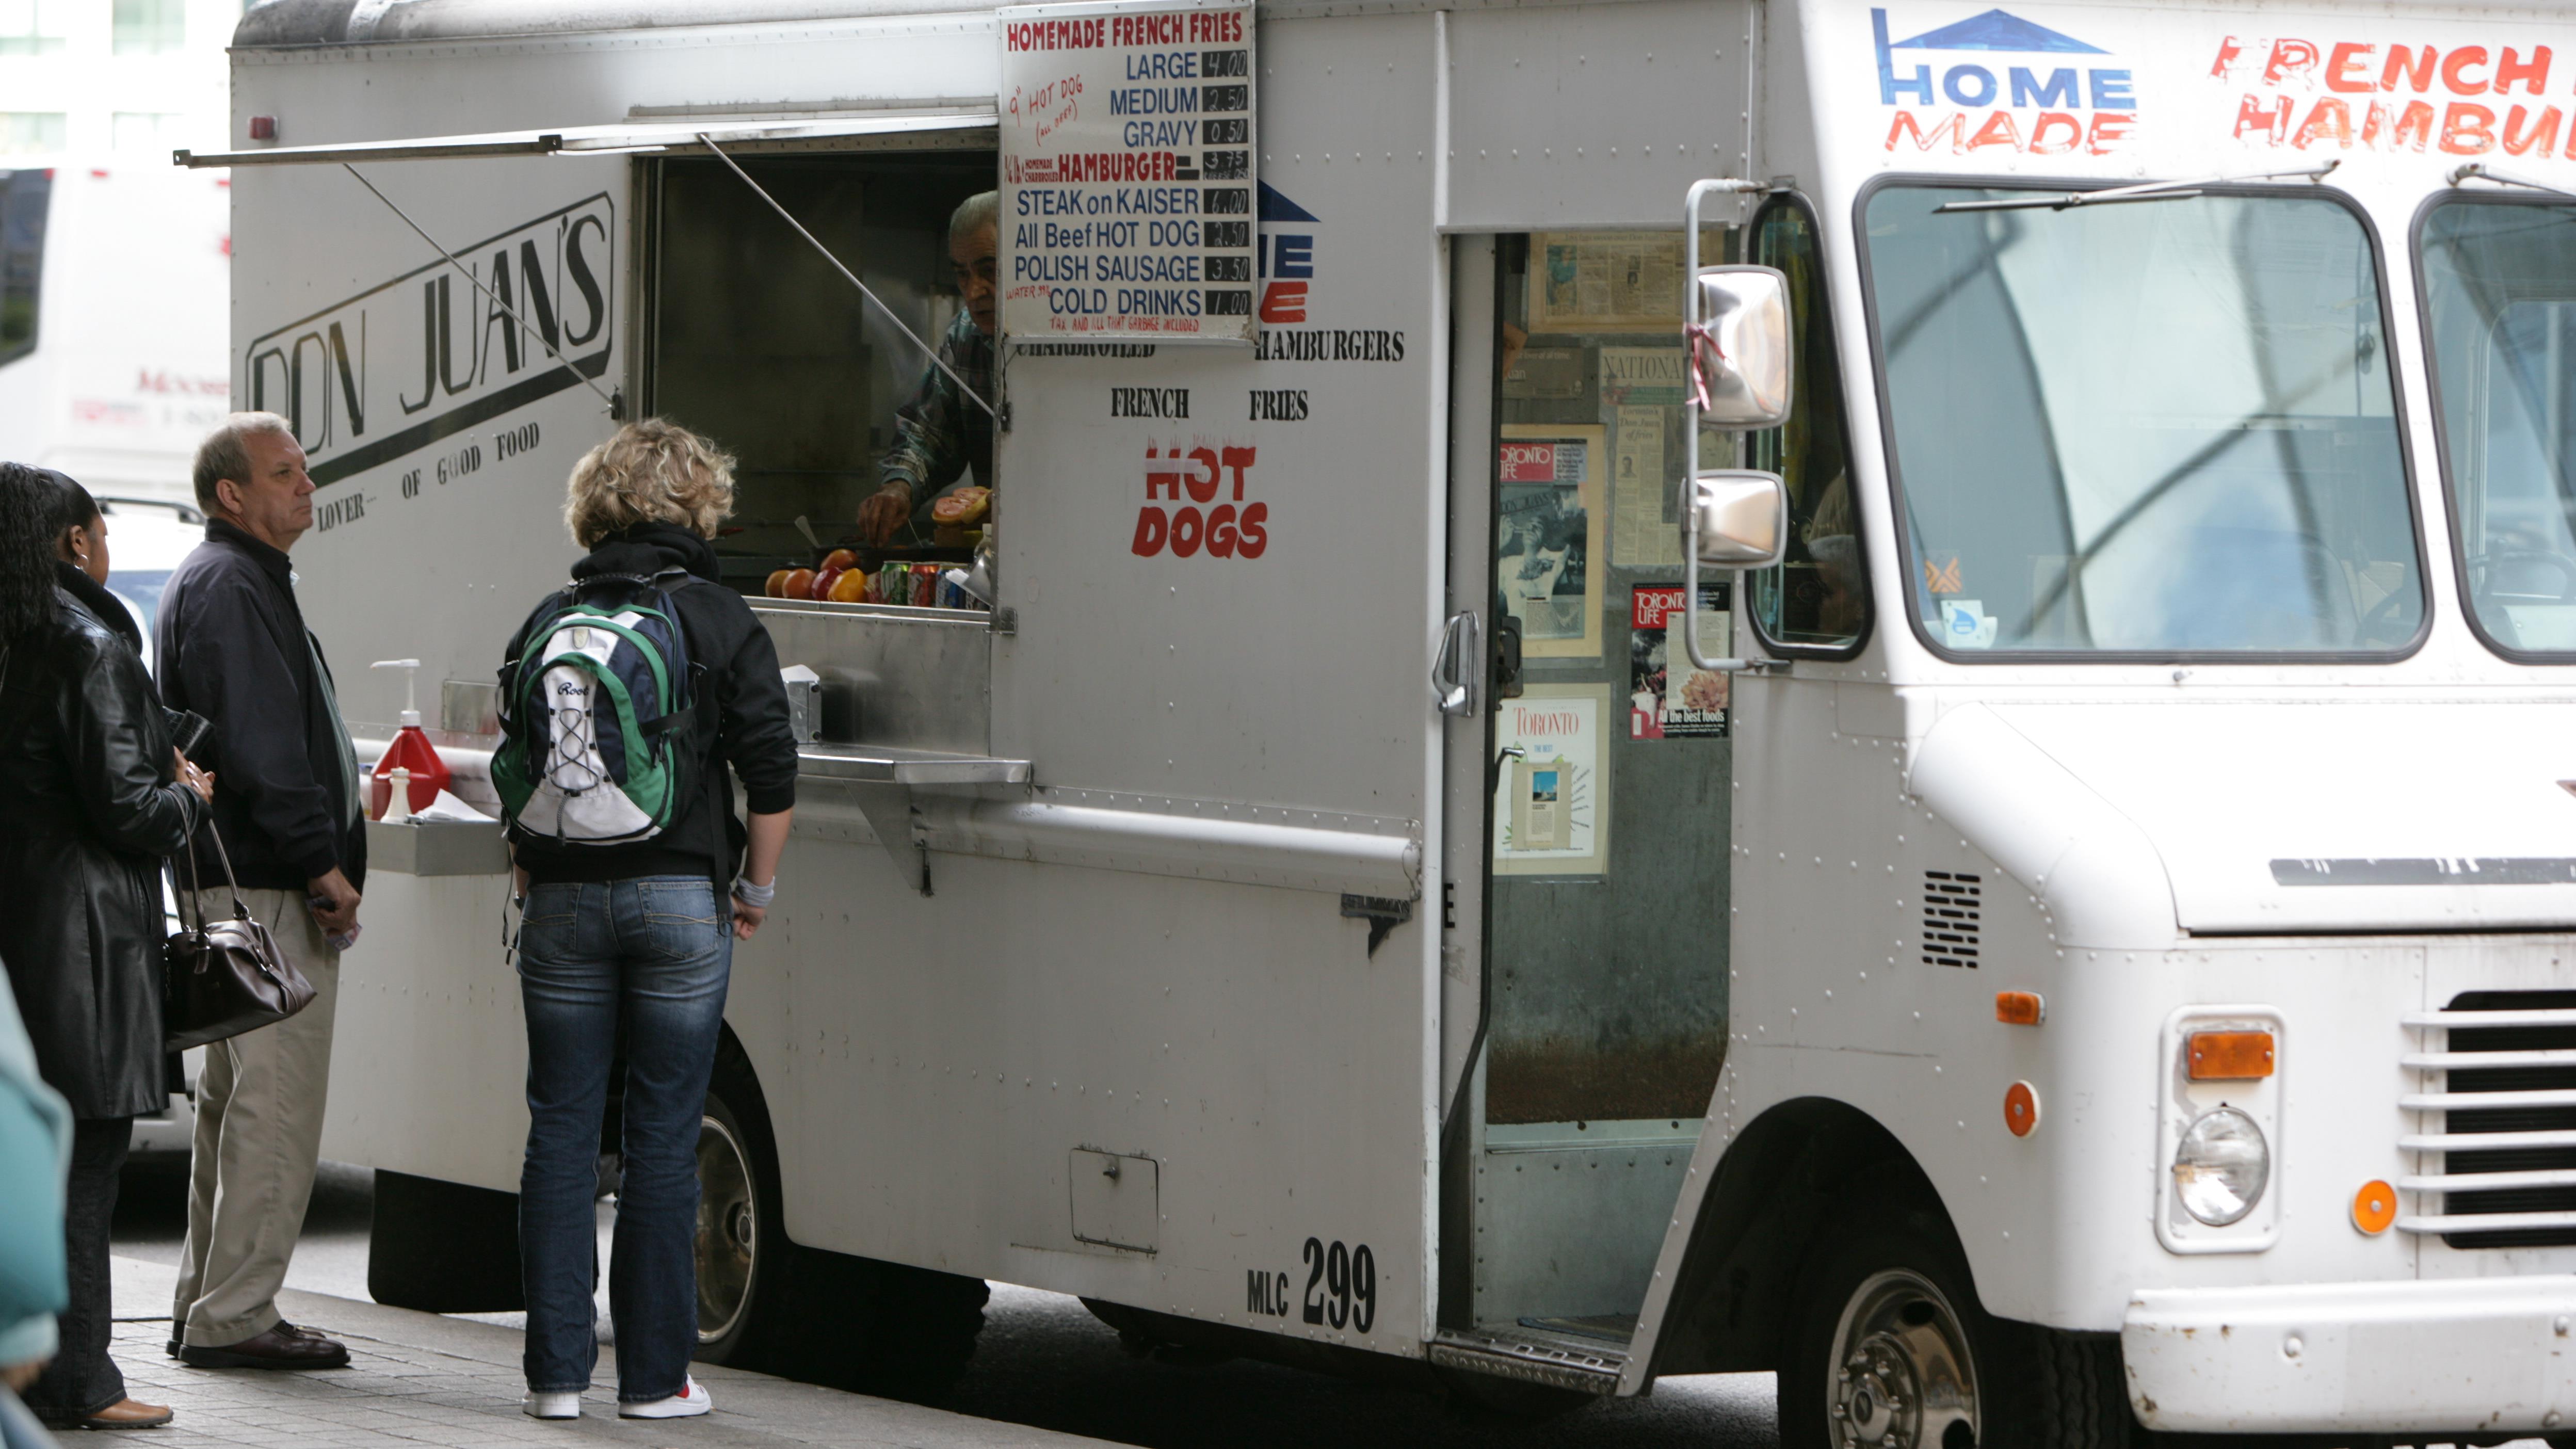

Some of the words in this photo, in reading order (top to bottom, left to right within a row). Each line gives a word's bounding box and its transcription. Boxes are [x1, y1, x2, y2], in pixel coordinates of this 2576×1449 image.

[1007, 18, 1105, 52] HOMEMADE
[1112, 14, 1184, 46] FRENCH
[1189, 11, 1243, 43] FRIES
[1126, 52, 1197, 81] LARGE
[1209, 52, 1246, 77] 4.00
[1029, 82, 1055, 116] HOT
[1060, 73, 1083, 99] DOG
[1877, 63, 2137, 109] HOME
[1110, 87, 1198, 116] MEDIUM
[1209, 87, 1245, 112] 2.50
[1123, 119, 1198, 148] GRAVY
[1211, 120, 1245, 143] 0.50
[1885, 110, 2138, 156] MADE
[1025, 158, 1053, 169] HOMEMADE
[1058, 151, 1176, 182] HAMBURGER
[1017, 188, 1083, 216] STEAK
[1087, 191, 1113, 215] on
[1116, 188, 1199, 215] KAISER
[1213, 190, 1246, 214] 6.00
[1015, 223, 1038, 249] All
[1045, 221, 1093, 248] Beef
[1097, 221, 1139, 248] HOT
[1149, 220, 1200, 248] DOG
[1214, 221, 1245, 247] 2.50
[1015, 255, 1088, 282] POLISH
[1096, 255, 1200, 282] SAUSAGE
[1213, 259, 1248, 281] 3.50
[1006, 285, 1035, 300] WATER
[1050, 288, 1107, 314] COLD
[1118, 288, 1201, 316] DRINKS
[1215, 293, 1247, 315] 1.00
[254, 310, 365, 456] DON
[399, 214, 606, 415] JUAN'S
[1049, 316, 1067, 331] TAX
[1072, 317, 1088, 331] AND
[1107, 315, 1125, 331] THAT
[1128, 316, 1160, 331] GARBAGE
[1163, 317, 1199, 332] INCLUDED
[1255, 330, 1405, 361] HAMBURGERS
[1508, 369, 1526, 379] uan
[1603, 356, 1682, 380] NATIONA
[1111, 388, 1189, 419] FRENCH
[1249, 389, 1309, 421] FRIES
[401, 468, 421, 500] OF
[437, 445, 481, 486] GOOD
[495, 421, 540, 462] FOOD
[1500, 445, 1551, 464] ORONTO
[1143, 444, 1257, 503] HOT
[1500, 463, 1518, 479] IFE
[1131, 501, 1268, 559] DOGS
[1638, 609, 1660, 624] LIFE
[1513, 706, 1580, 736] TORONTO
[1658, 709, 1668, 723] All
[1669, 709, 1682, 723] the
[1683, 708, 1701, 723] best
[1702, 707, 1725, 722] foods
[1247, 1269, 1289, 1317] MLC
[1302, 1236, 1376, 1334] 299
